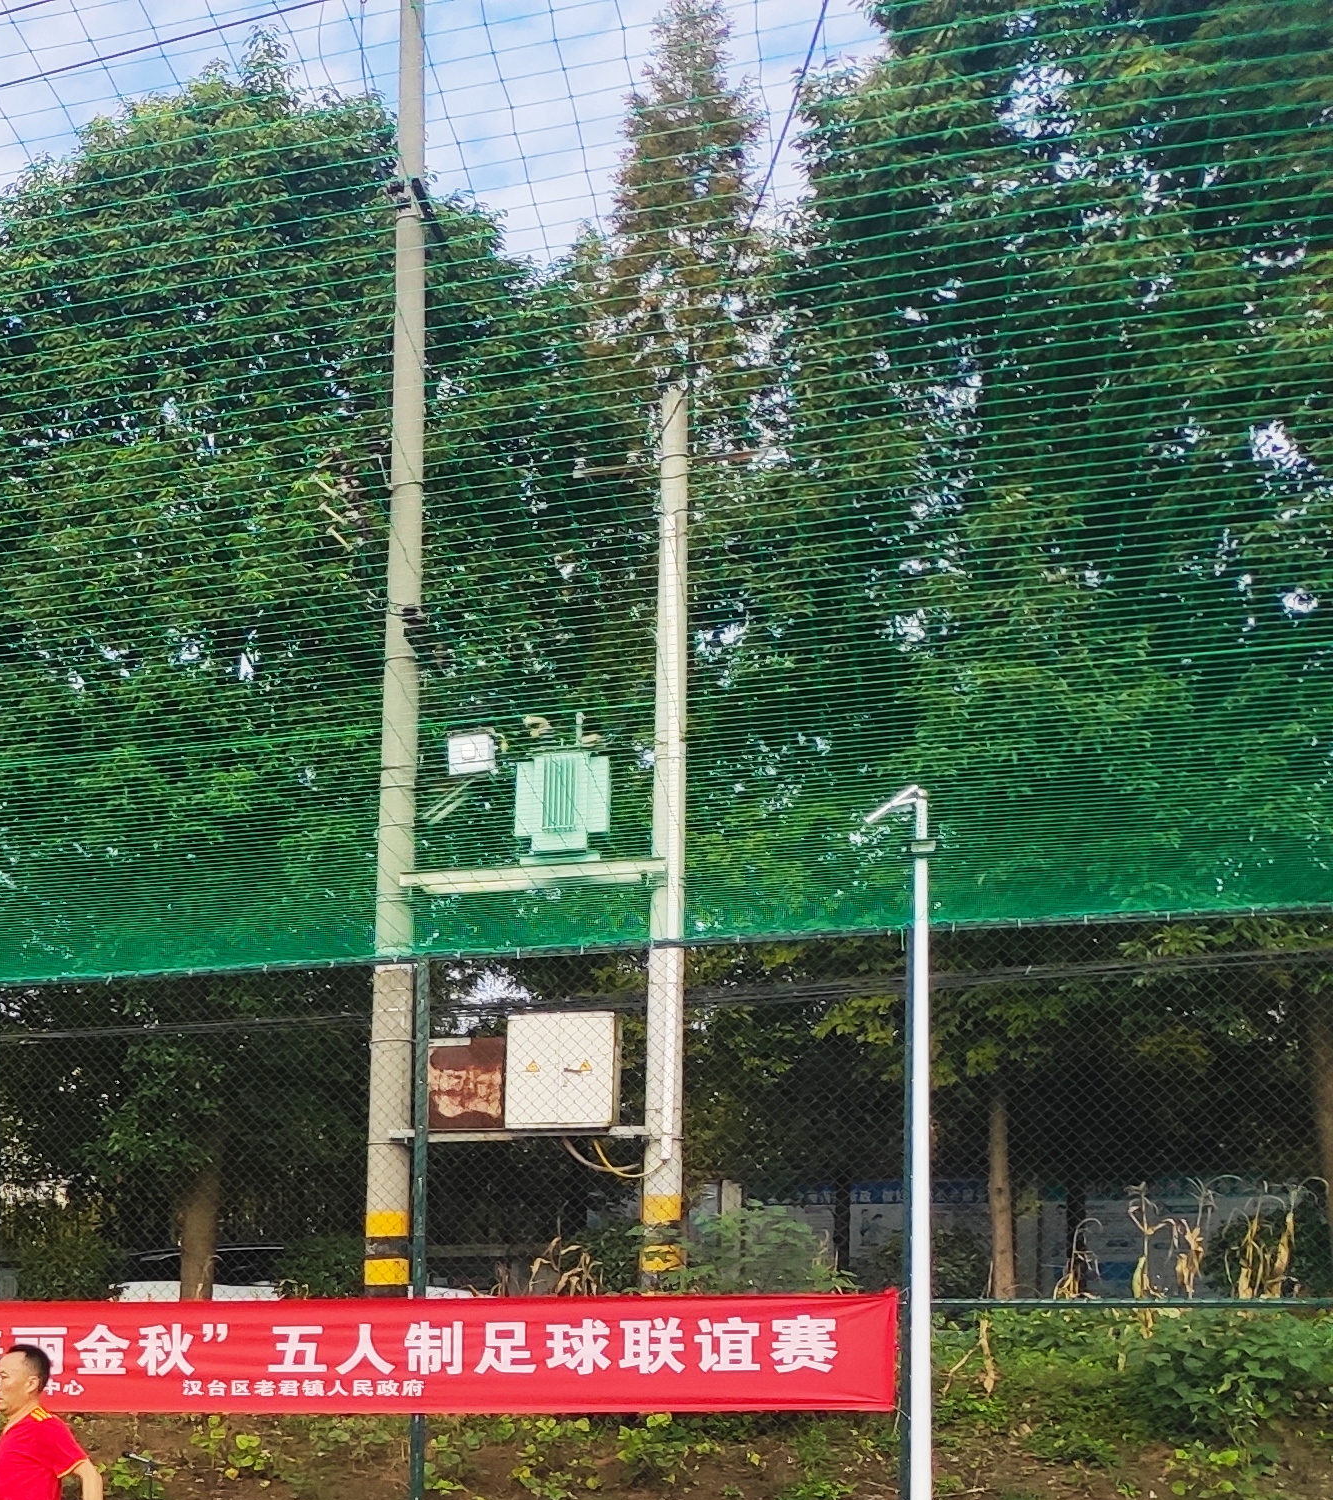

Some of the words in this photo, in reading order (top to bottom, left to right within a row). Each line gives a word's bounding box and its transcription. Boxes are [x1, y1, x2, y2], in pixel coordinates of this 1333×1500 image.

[182, 1378, 425, 1397] 汉台区老君镇人民政府
